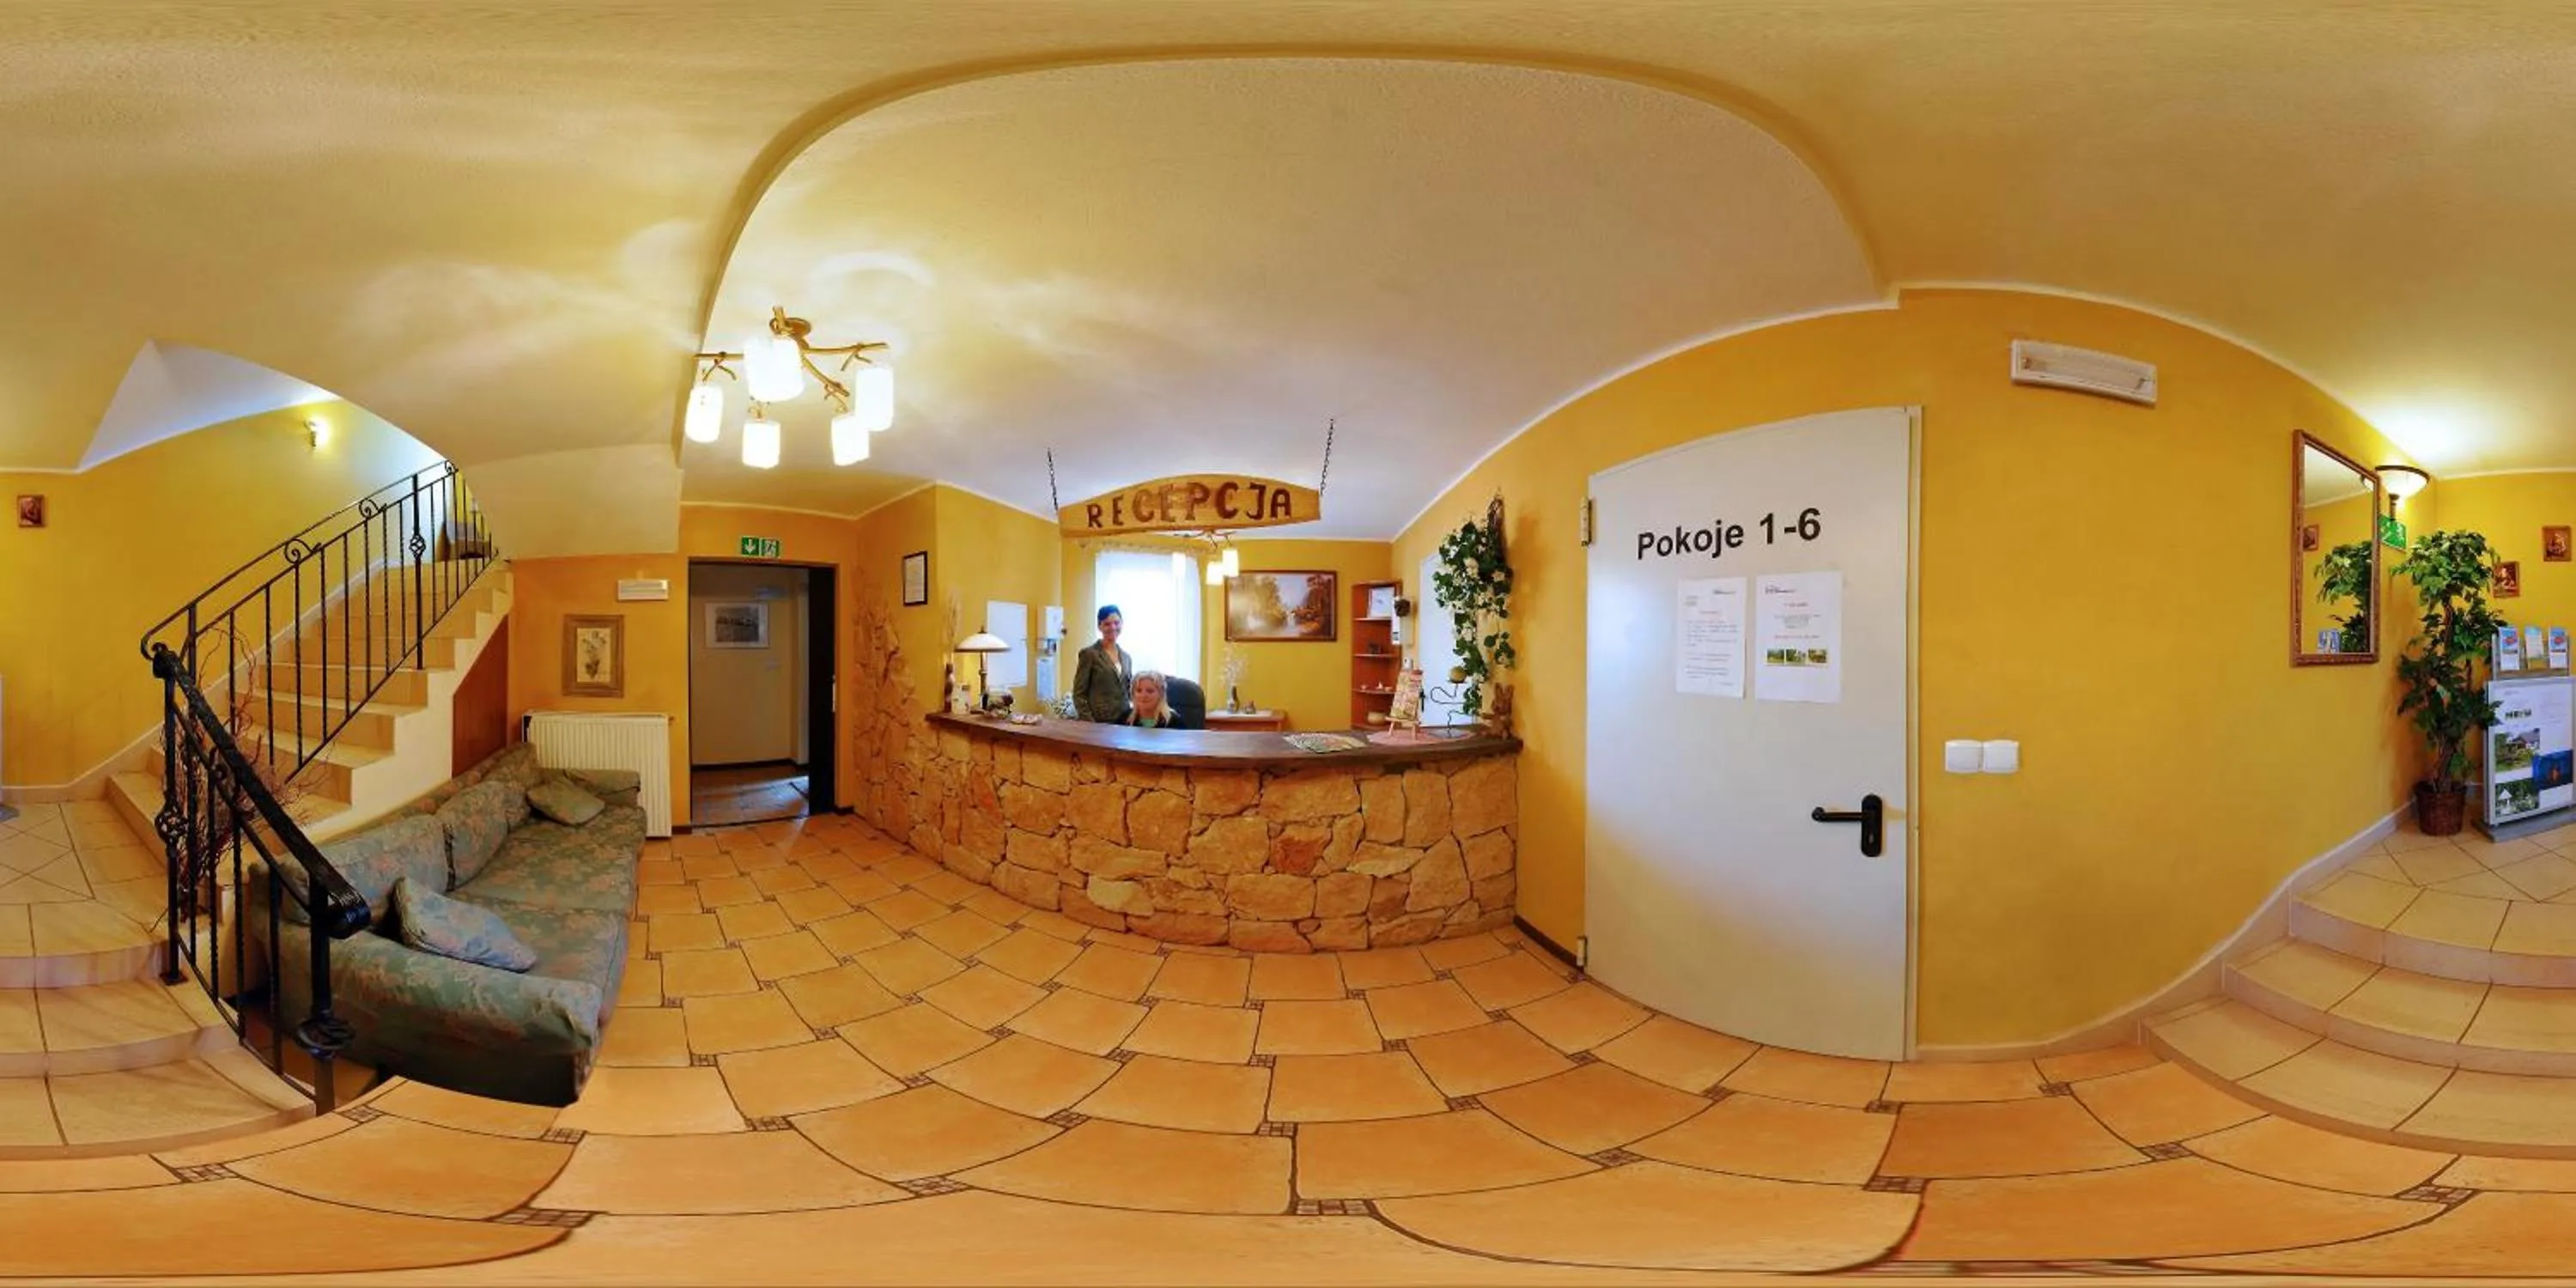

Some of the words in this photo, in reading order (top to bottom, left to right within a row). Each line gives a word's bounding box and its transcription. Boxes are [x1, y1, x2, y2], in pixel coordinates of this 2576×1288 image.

[1086, 481, 1292, 528] RECEPCJA
[1637, 519, 1744, 560] Pokoje
[1759, 507, 1821, 545] 1-6
